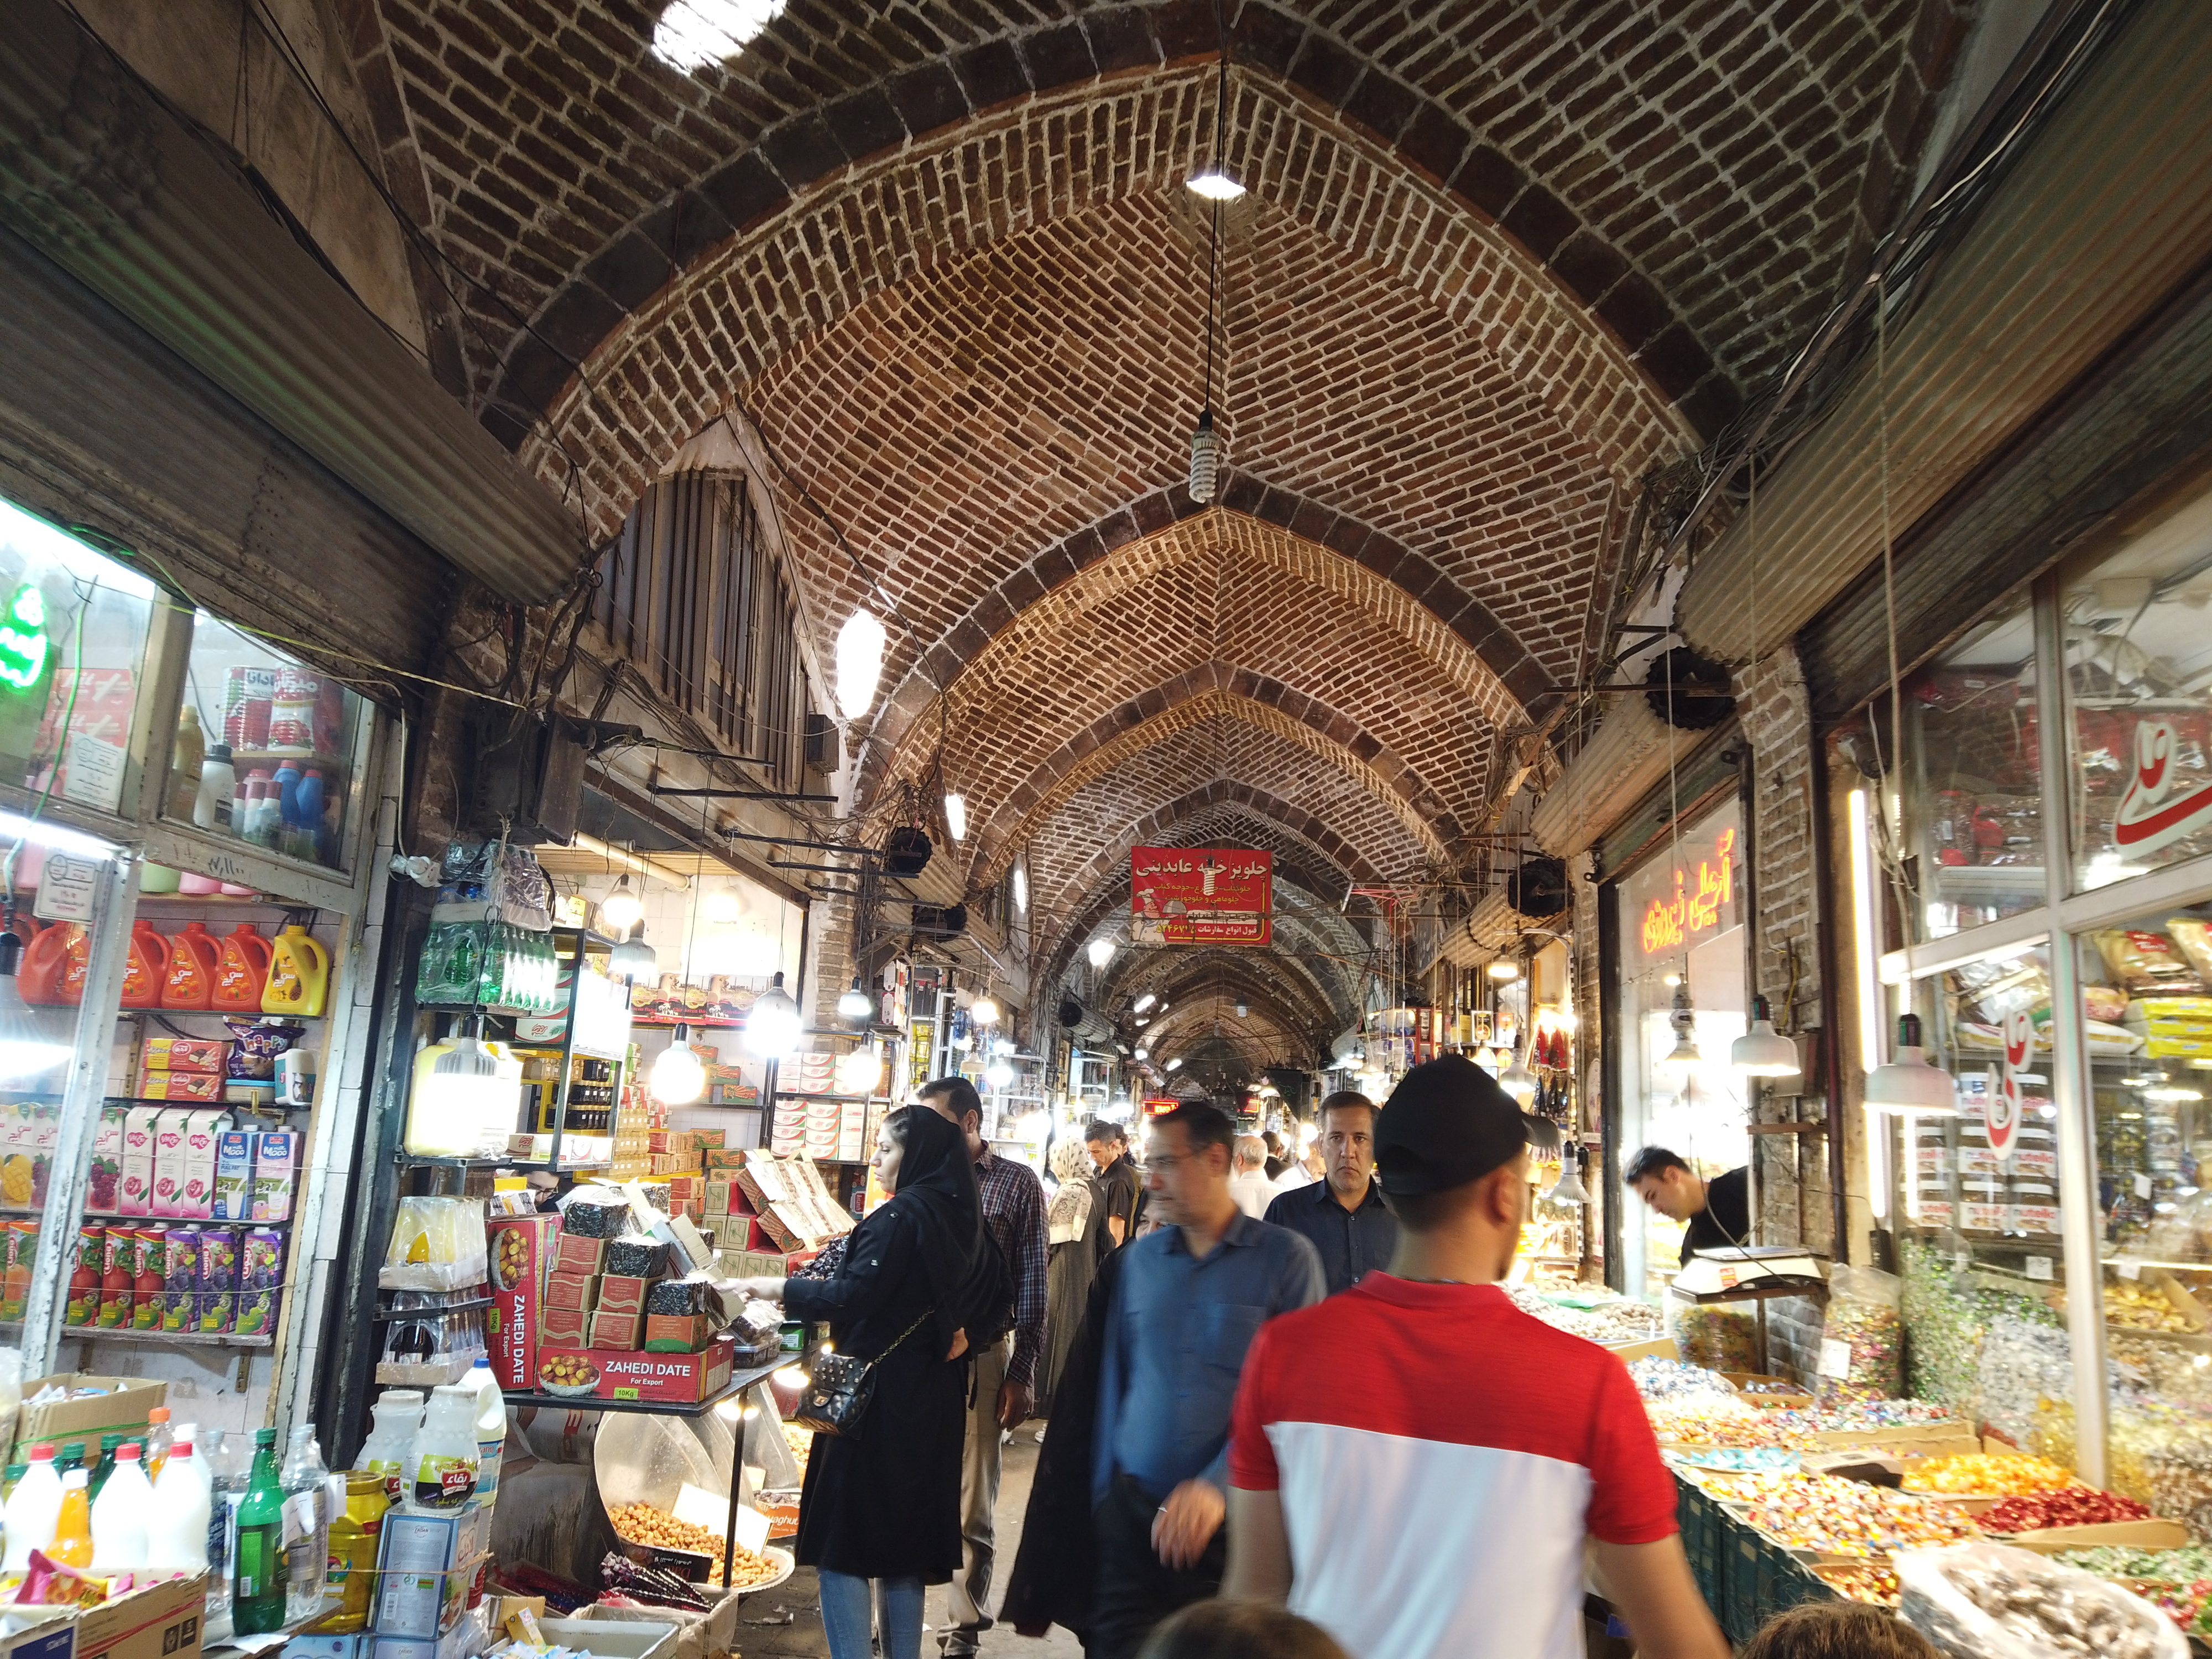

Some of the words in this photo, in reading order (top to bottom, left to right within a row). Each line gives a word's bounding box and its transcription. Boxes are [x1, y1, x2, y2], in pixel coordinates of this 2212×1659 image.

[1136, 858, 1192, 877] عابدینی
[1197, 925, 1224, 933] سفارشات
[1225, 926, 1241, 935] انواع
[1242, 925, 1257, 936] قبول
[244, 1035, 288, 1054] happy
[513, 1295, 525, 1345] ZAHEDI
[502, 1337, 510, 1358] Export
[513, 1348, 524, 1384] DATE
[605, 1360, 653, 1375] ZAHEDI
[656, 1364, 691, 1377] DATE
[642, 1378, 664, 1386] Export
[618, 1390, 634, 1399] 10Kg
[446, 1473, 467, 1485] بقاء
